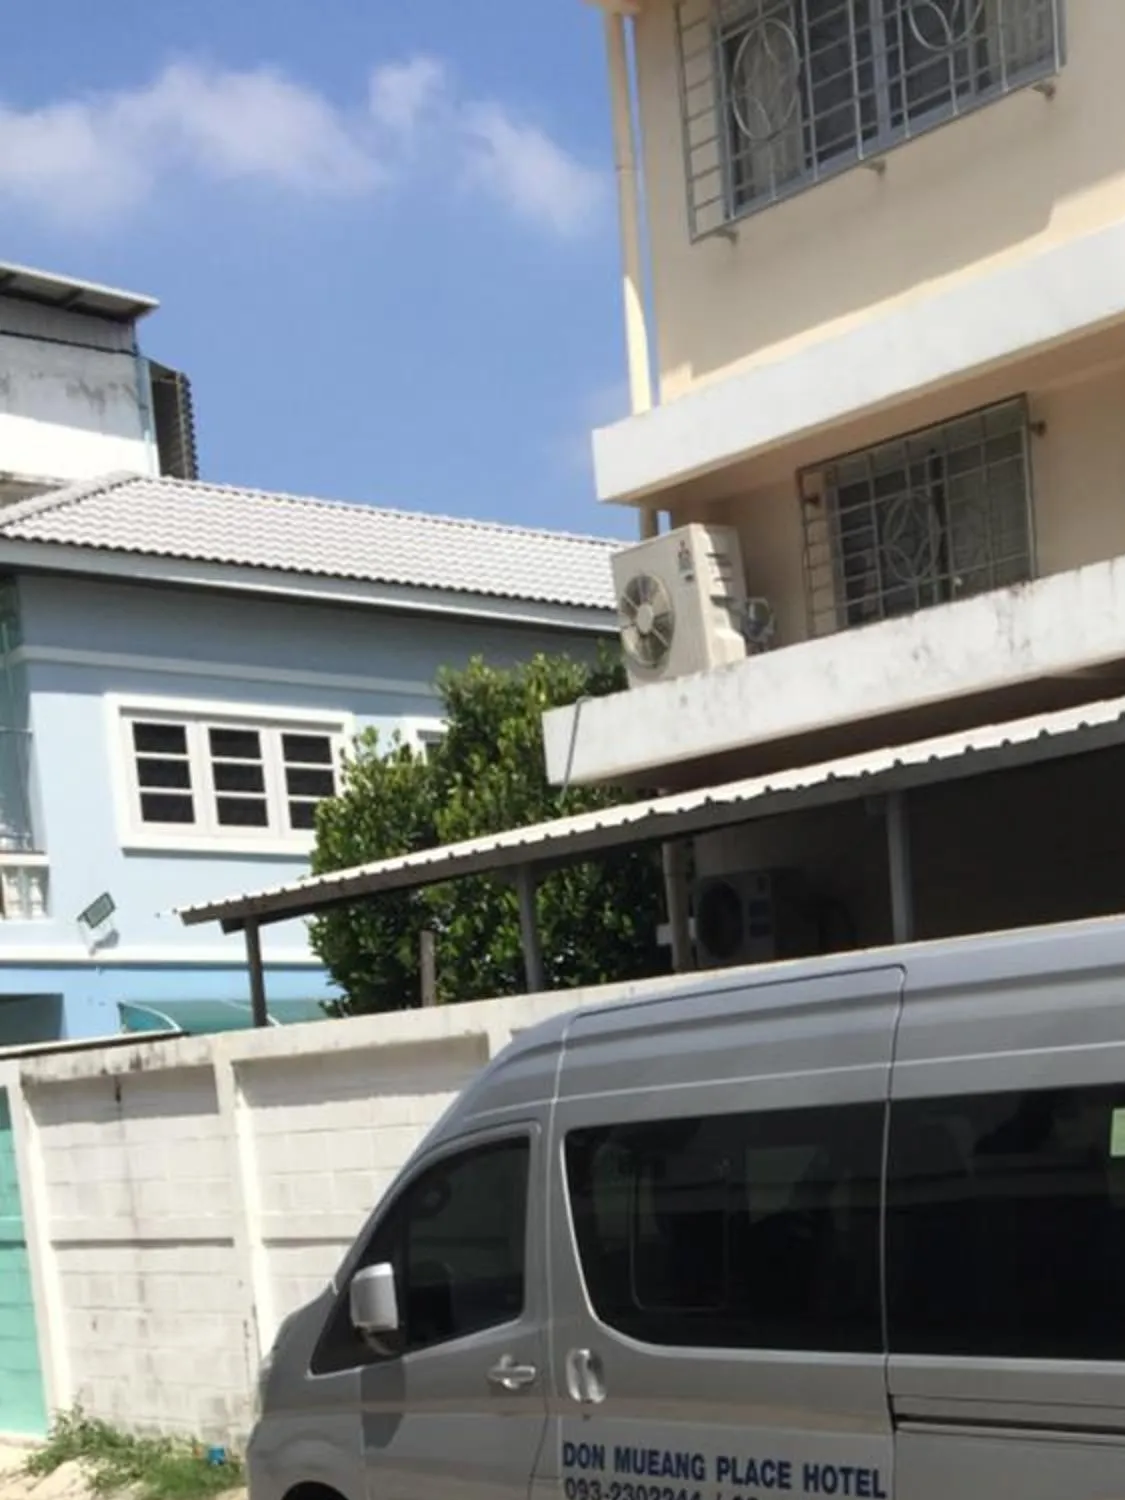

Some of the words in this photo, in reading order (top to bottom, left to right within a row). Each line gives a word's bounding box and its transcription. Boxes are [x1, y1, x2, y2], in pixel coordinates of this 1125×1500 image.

[562, 1441, 605, 1470] DON
[614, 1446, 705, 1482] MUEANG
[716, 1456, 792, 1490] PLACE
[803, 1463, 887, 1499] HOTEL
